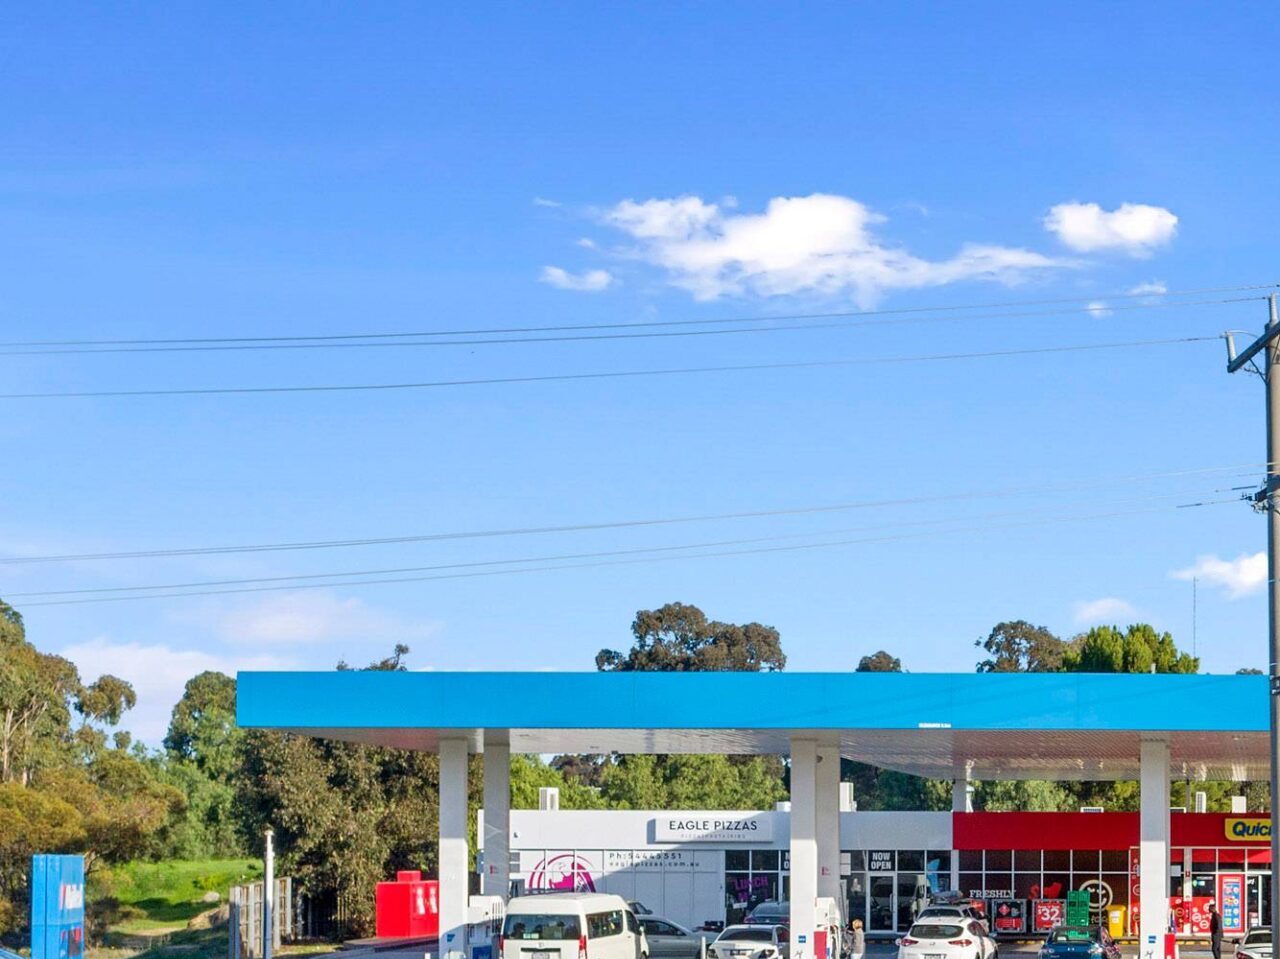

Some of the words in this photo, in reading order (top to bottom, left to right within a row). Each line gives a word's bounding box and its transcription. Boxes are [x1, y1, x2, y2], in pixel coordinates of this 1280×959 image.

[669, 820, 709, 831] EAGLE
[714, 820, 757, 831] PIZZAS
[872, 852, 891, 860] NOW
[871, 861, 892, 869] OPEN
[969, 889, 1016, 898] FRESHLY
